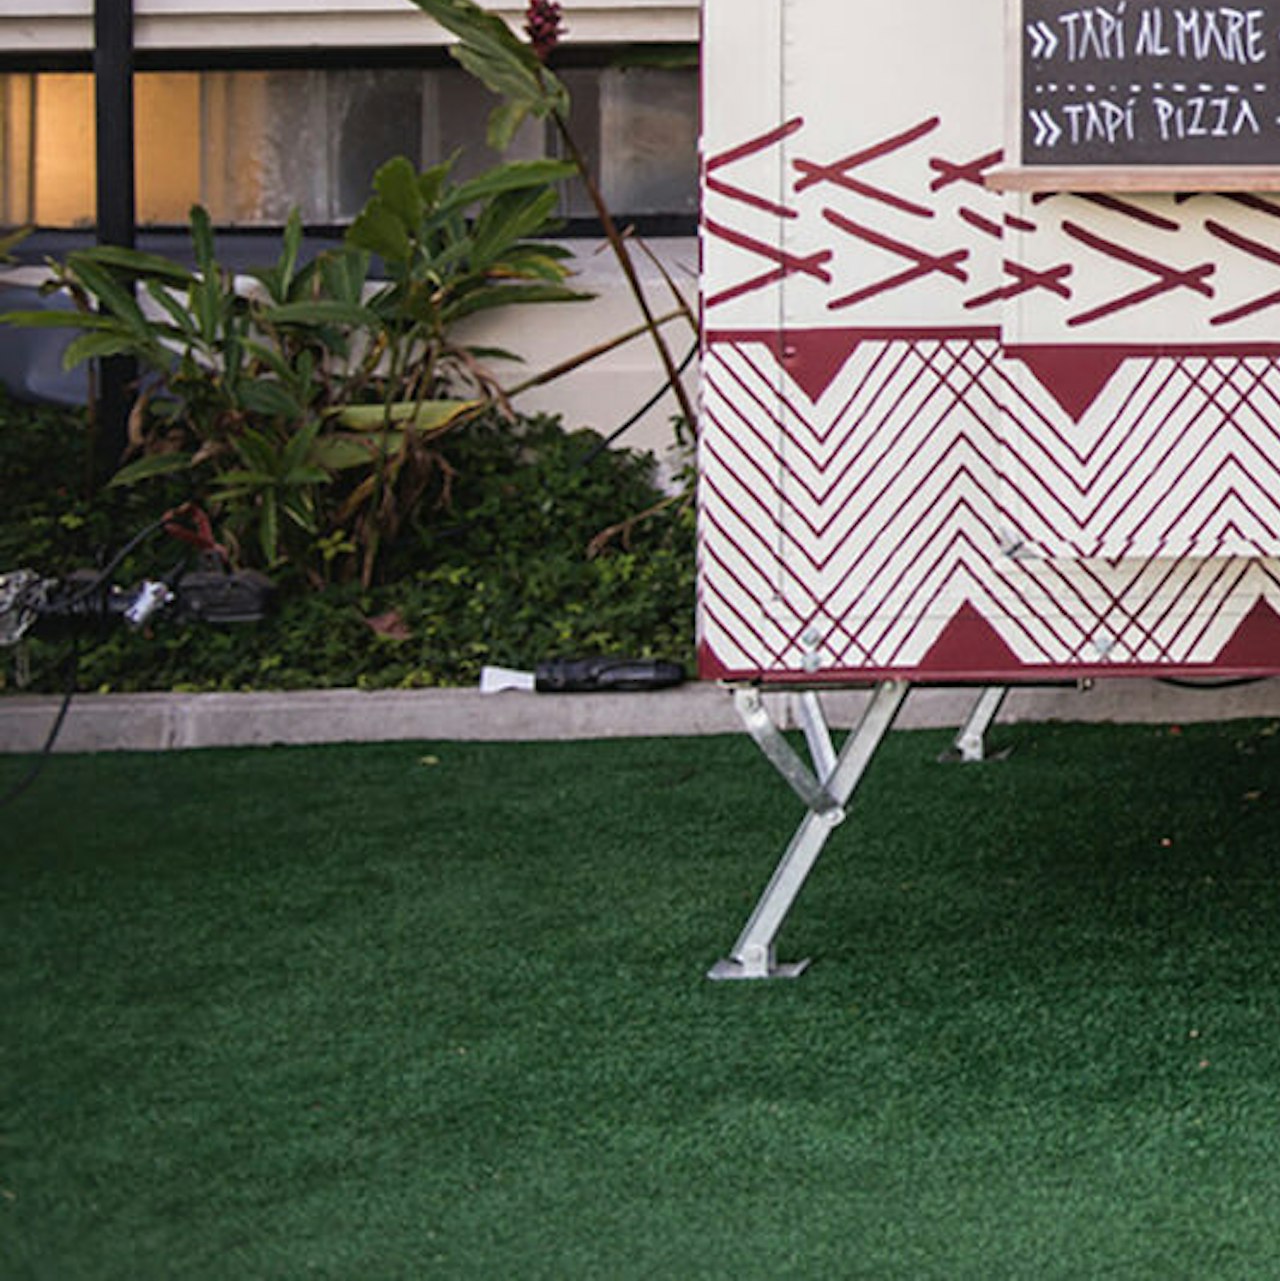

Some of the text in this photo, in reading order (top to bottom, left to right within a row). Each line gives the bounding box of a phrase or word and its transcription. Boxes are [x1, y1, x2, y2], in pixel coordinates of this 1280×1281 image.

[1058, 0, 1266, 65] TAPÍ AL MARE
[1062, 97, 1260, 144] TAPÍ PIZZA
